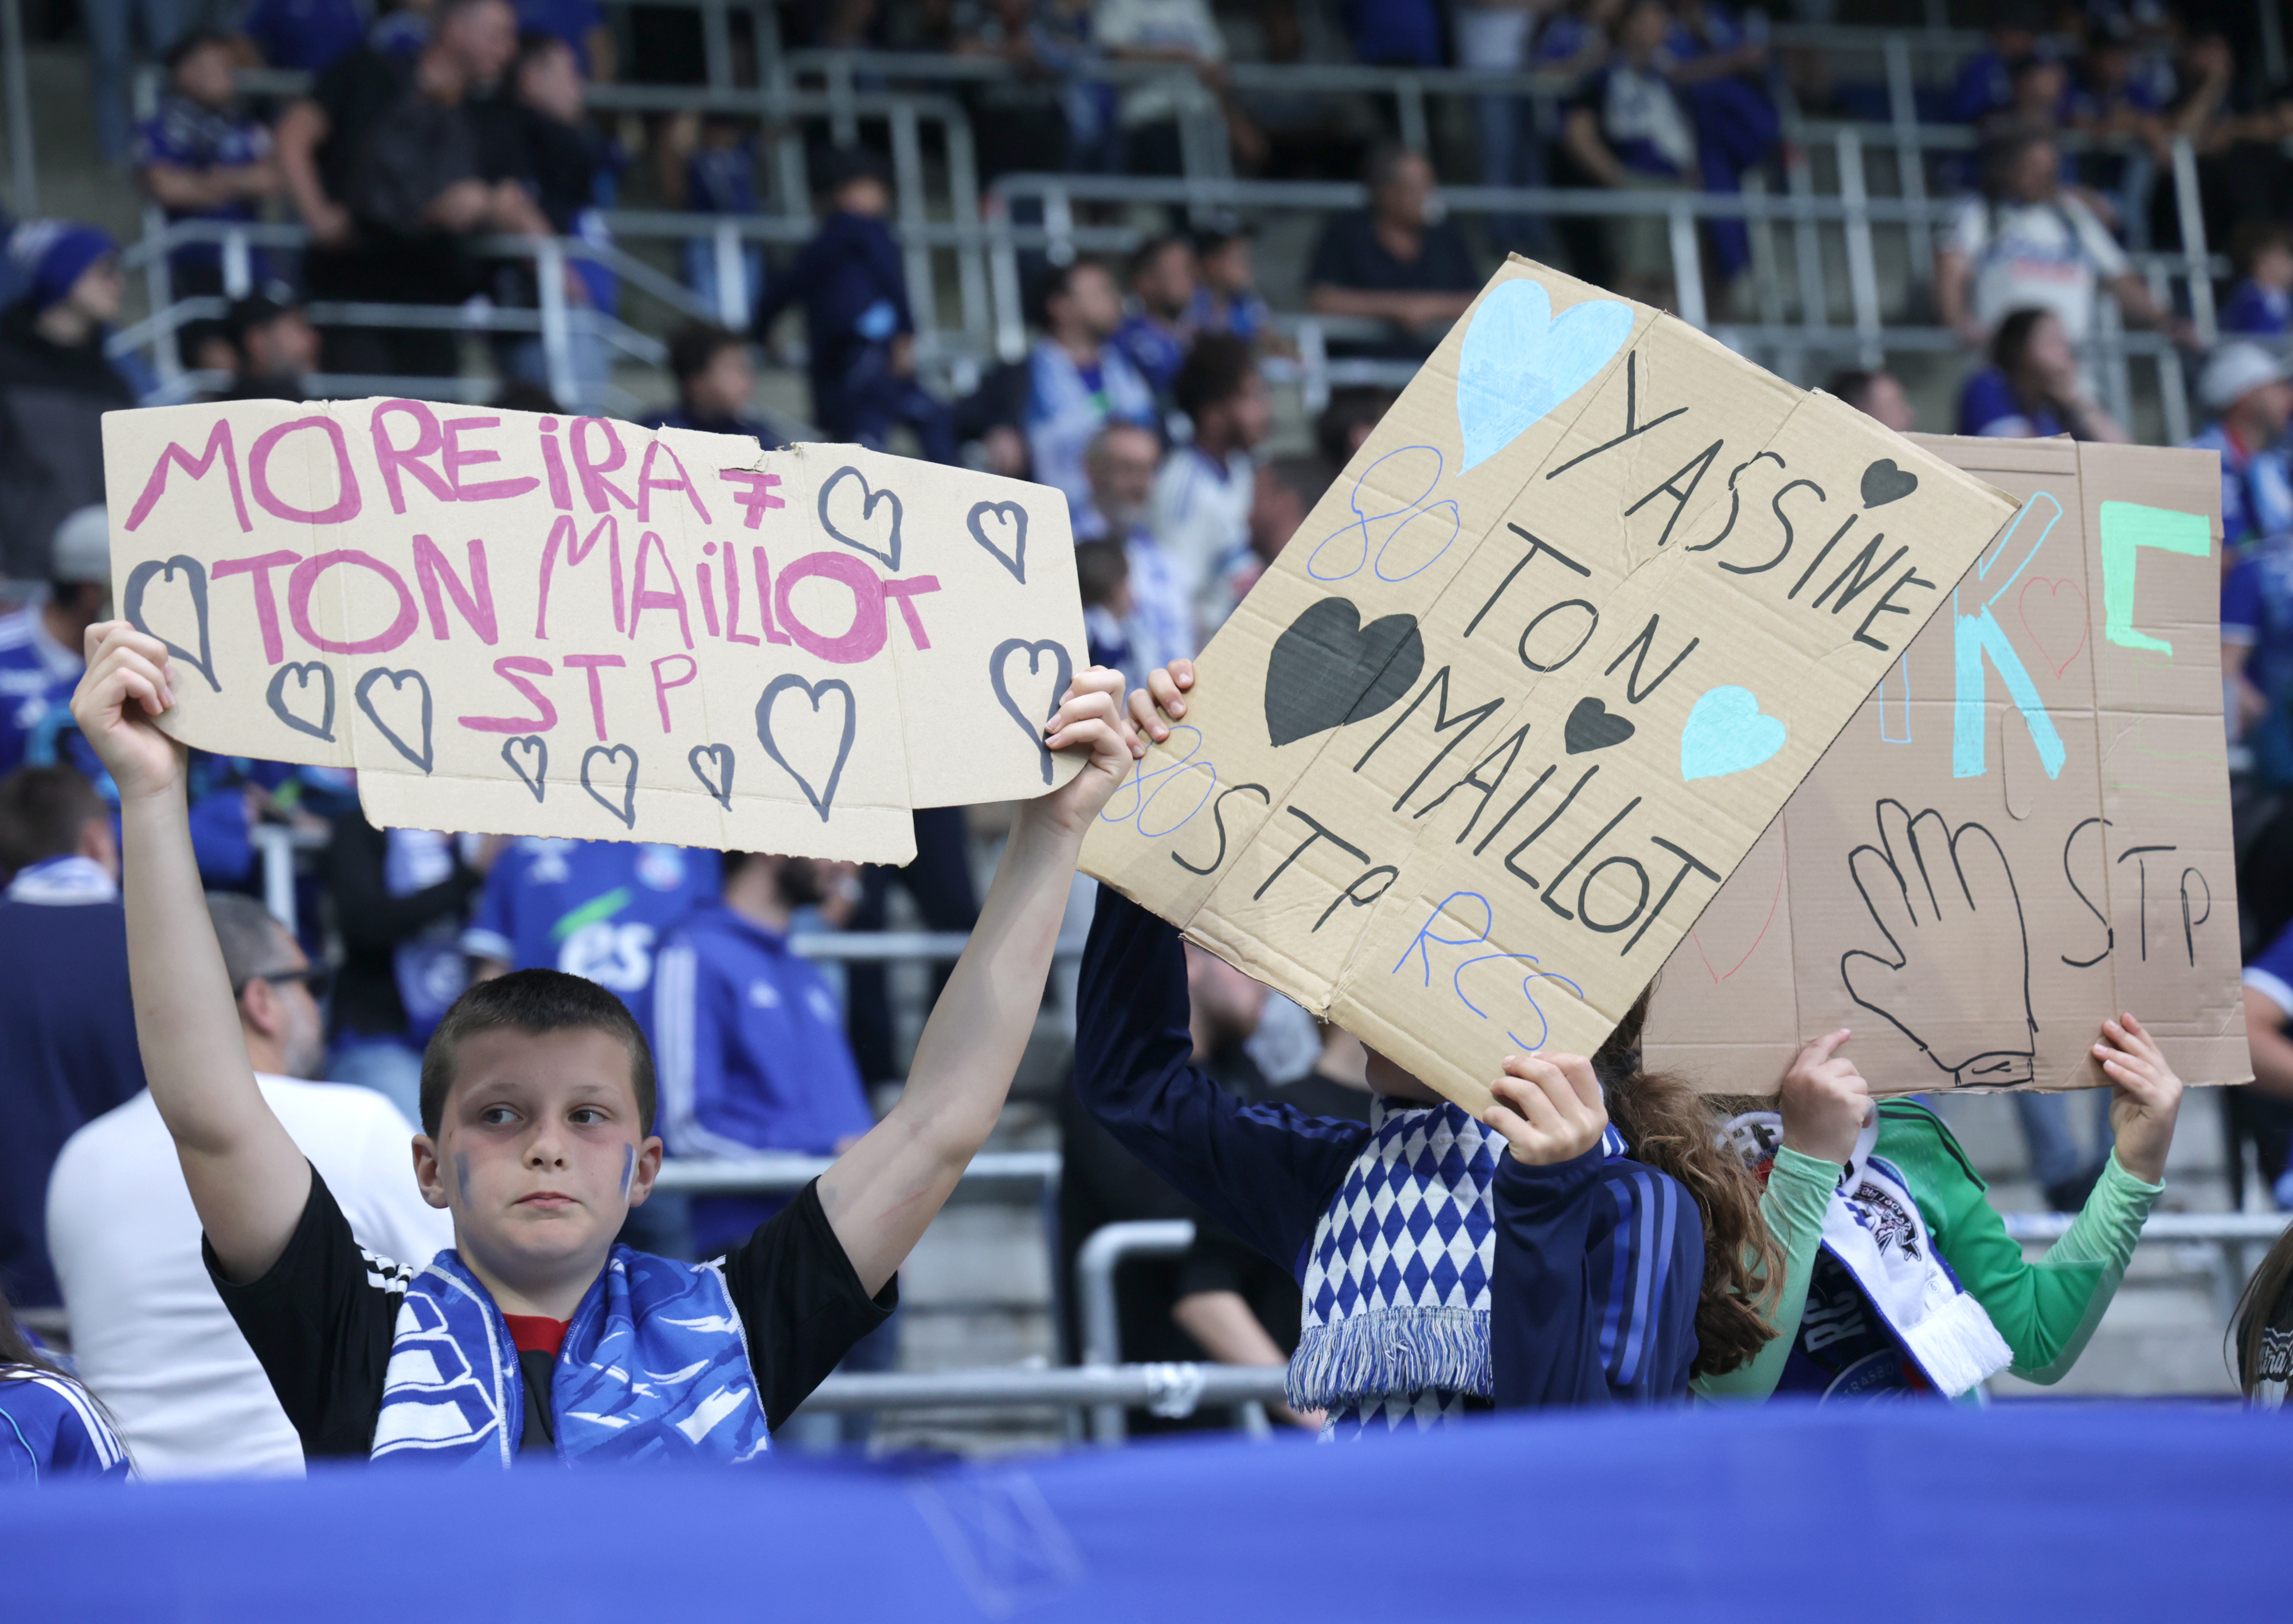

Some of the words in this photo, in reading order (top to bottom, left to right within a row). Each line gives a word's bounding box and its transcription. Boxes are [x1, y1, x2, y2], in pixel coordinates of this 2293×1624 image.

[719, 468, 785, 530] 7
[1308, 445, 1459, 581] 80
[1545, 350, 1936, 652] YASSINE
[210, 534, 498, 665] TON
[1464, 522, 1699, 705] TON
[458, 654, 697, 741] STP
[1099, 725, 1216, 837] 80
[1353, 666, 1721, 956] MAILLOT
[1172, 783, 1400, 932] STP
[1392, 891, 1584, 1051] RCS
